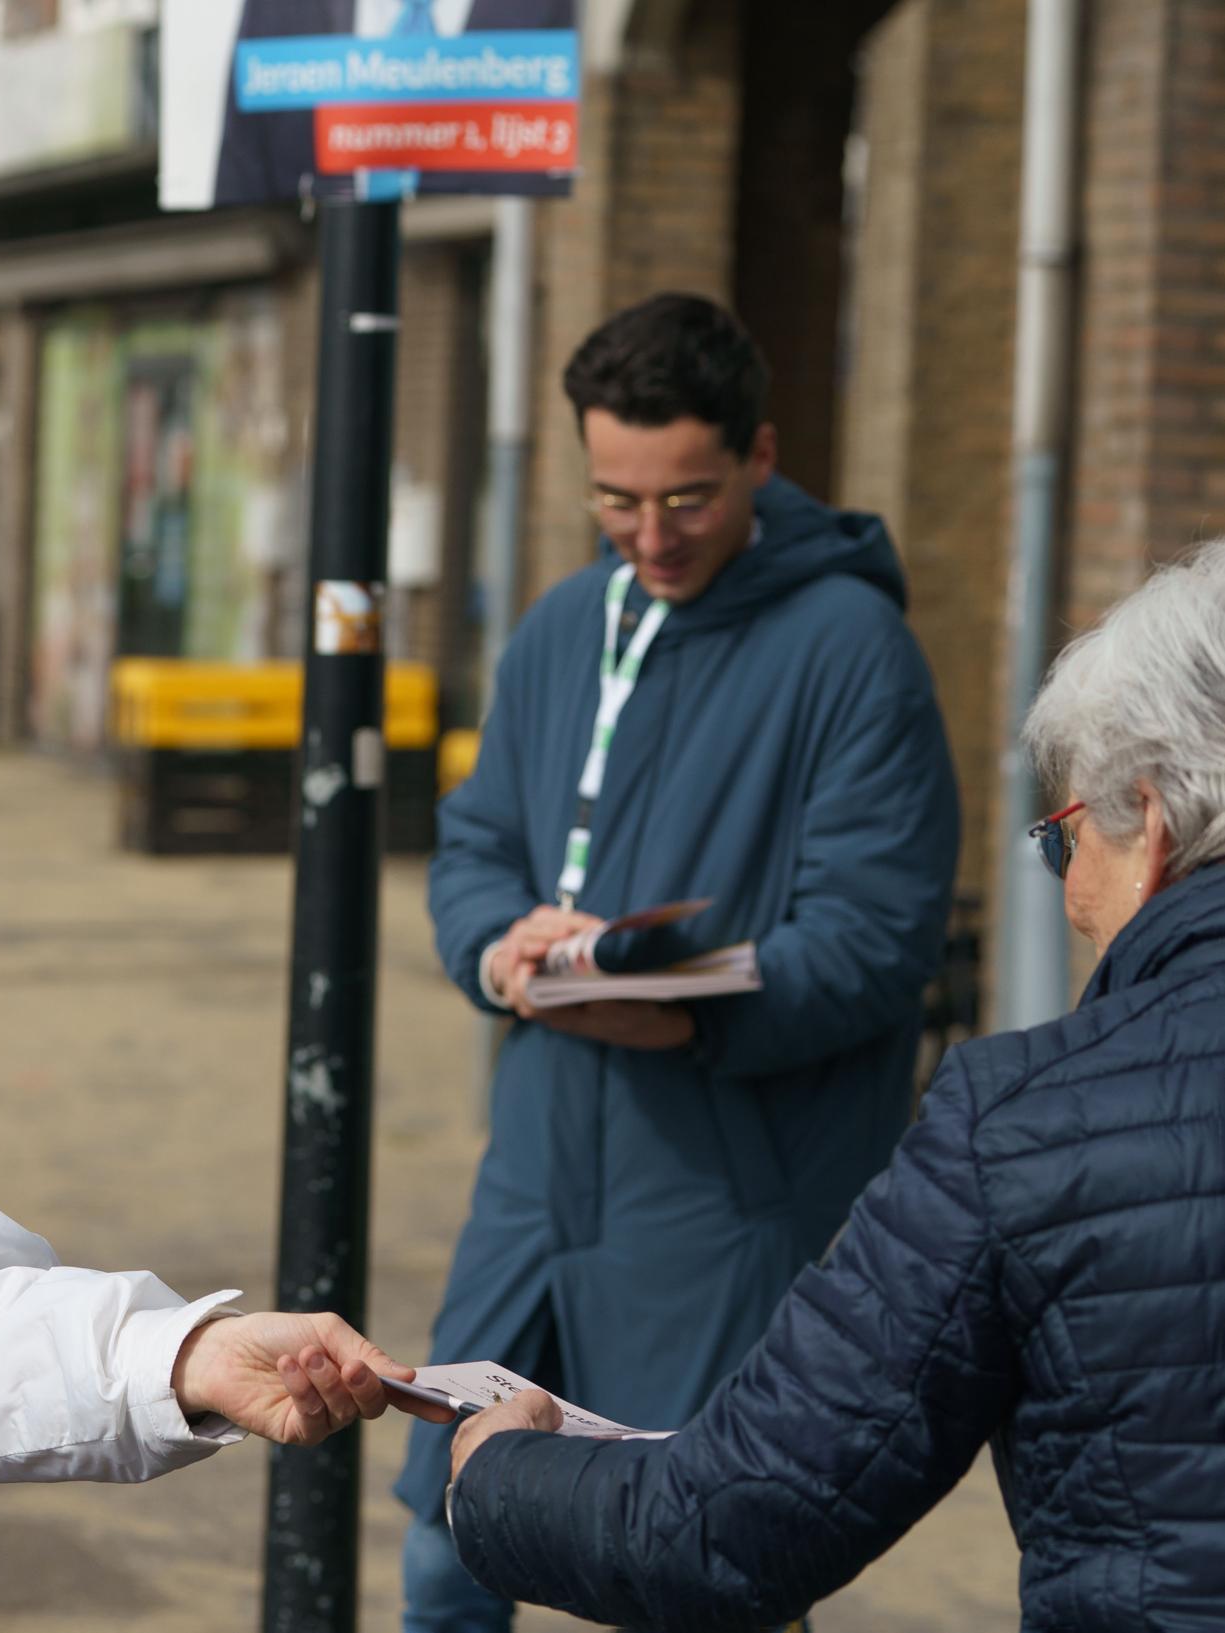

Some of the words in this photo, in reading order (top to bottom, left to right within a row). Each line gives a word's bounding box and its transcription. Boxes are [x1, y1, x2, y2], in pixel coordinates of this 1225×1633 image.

[245, 57, 343, 95] Jeroen
[347, 50, 572, 95] Meulenberg
[328, 124, 464, 151] nummer
[493, 114, 550, 157] lijst
